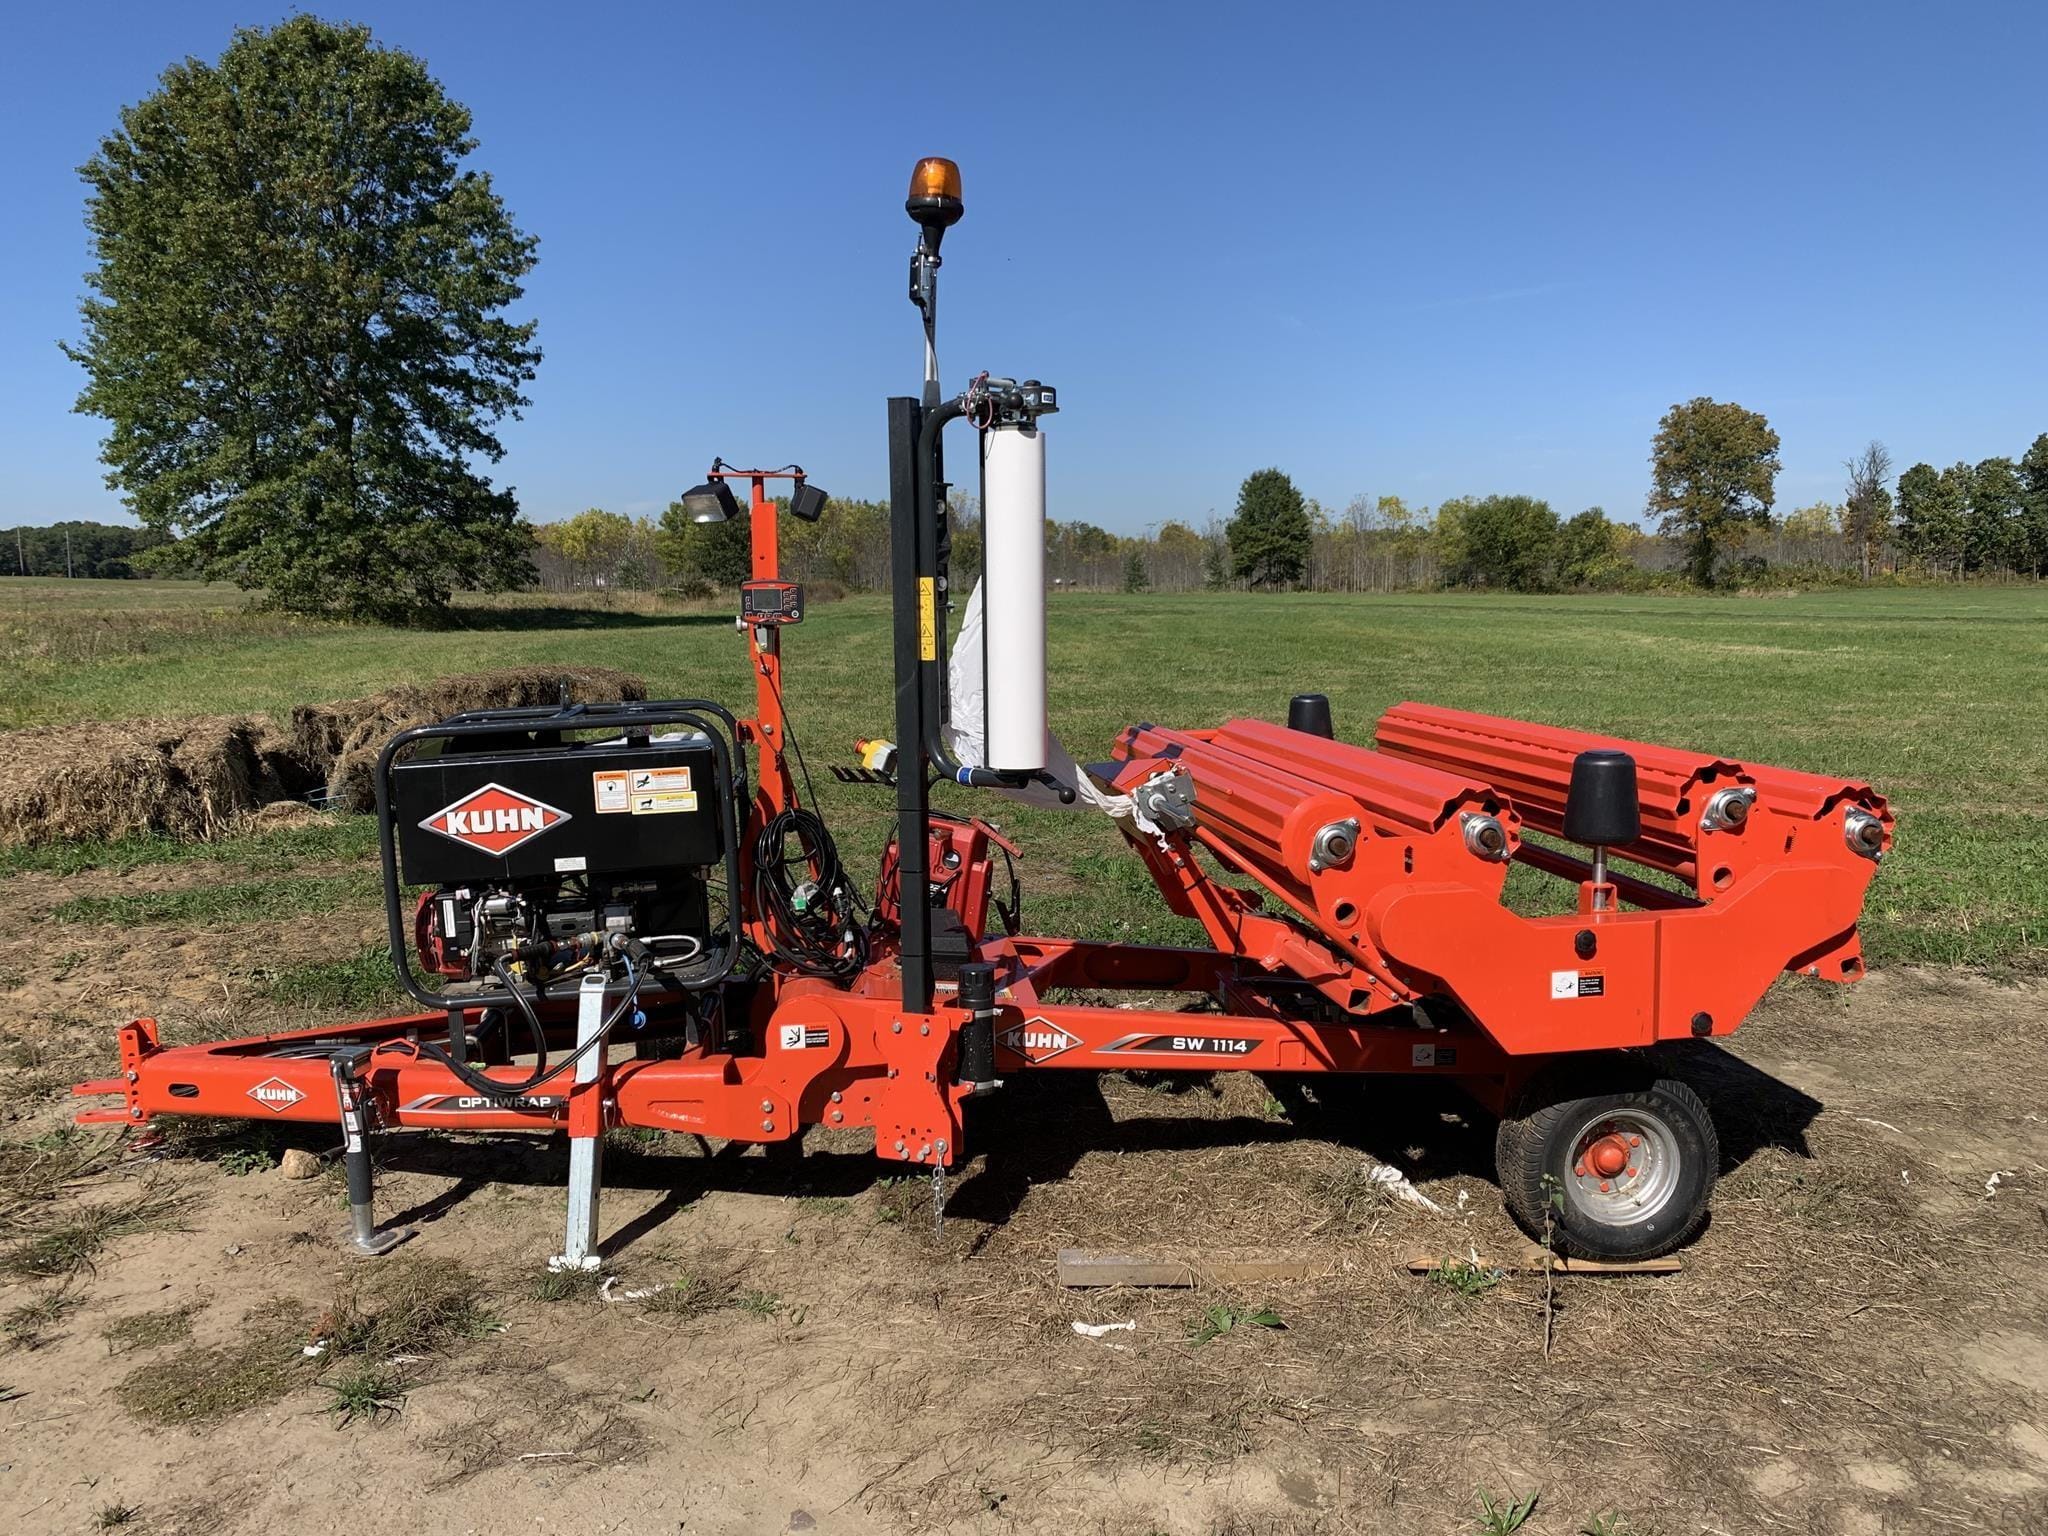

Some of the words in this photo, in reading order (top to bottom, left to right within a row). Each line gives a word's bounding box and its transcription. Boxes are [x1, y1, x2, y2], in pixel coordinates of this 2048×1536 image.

[446, 807, 545, 835] KUHN
[1007, 1032, 1068, 1049] KUHN
[1172, 1037, 1205, 1051] SW
[1212, 1039, 1248, 1053] 1114
[256, 1088, 297, 1102] KUHN
[458, 1096, 552, 1109] OPTIWRAP
